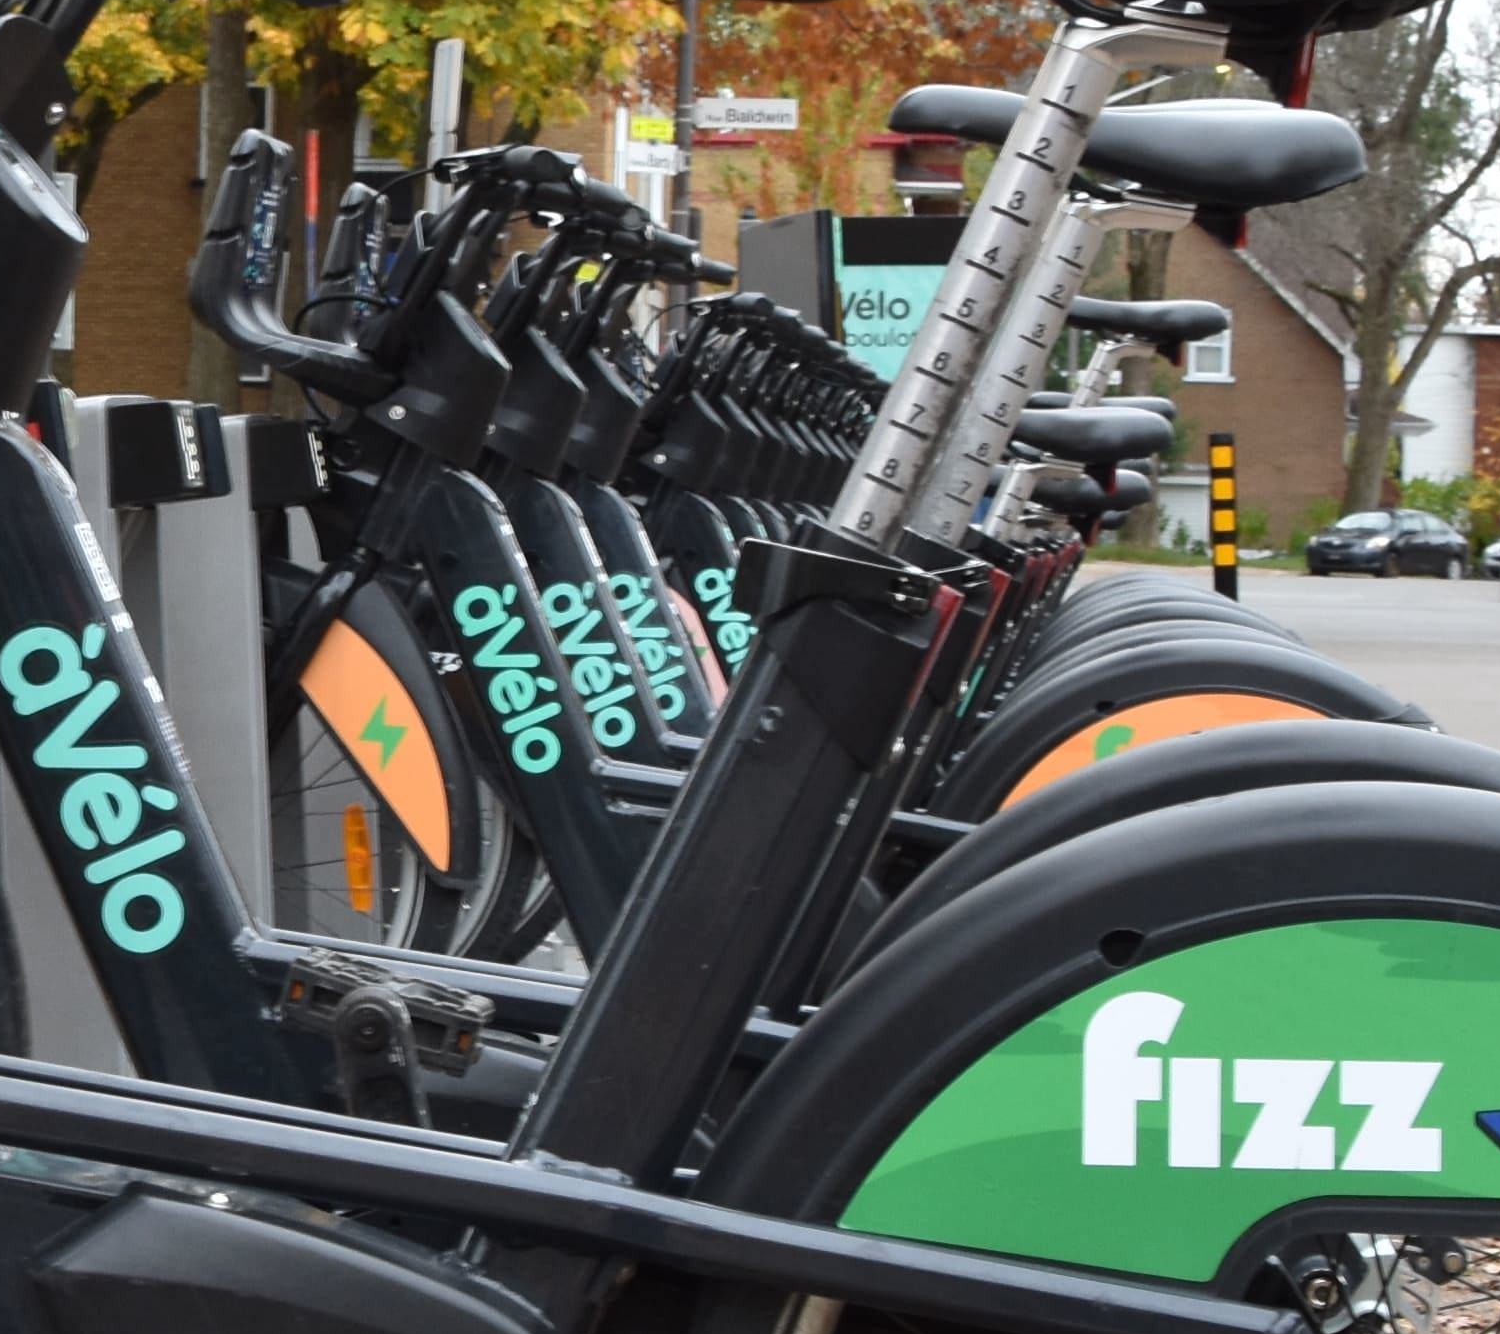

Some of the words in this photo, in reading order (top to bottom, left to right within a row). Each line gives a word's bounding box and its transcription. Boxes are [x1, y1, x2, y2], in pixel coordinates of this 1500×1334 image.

[1065, 85, 1075, 103] 1
[726, 108, 792, 123] Baldwin
[1033, 138, 1052, 158] 2
[1009, 192, 1027, 210] 3
[983, 247, 1000, 265] 4
[1074, 246, 1083, 259] 1
[1051, 284, 1065, 298] 2
[957, 298, 977, 317] 5
[1032, 323, 1047, 338] 3
[932, 352, 951, 370] 6
[1013, 365, 1027, 378] 4
[909, 403, 926, 423] 7
[995, 404, 1009, 418] 5
[977, 443, 991, 457] 6
[882, 459, 900, 477] 8
[959, 482, 973, 495] 7
[858, 512, 874, 530] 9
[695, 567, 759, 675] àVél
[453, 584, 562, 774] àVélo
[1082, 991, 1443, 1172] fizz
